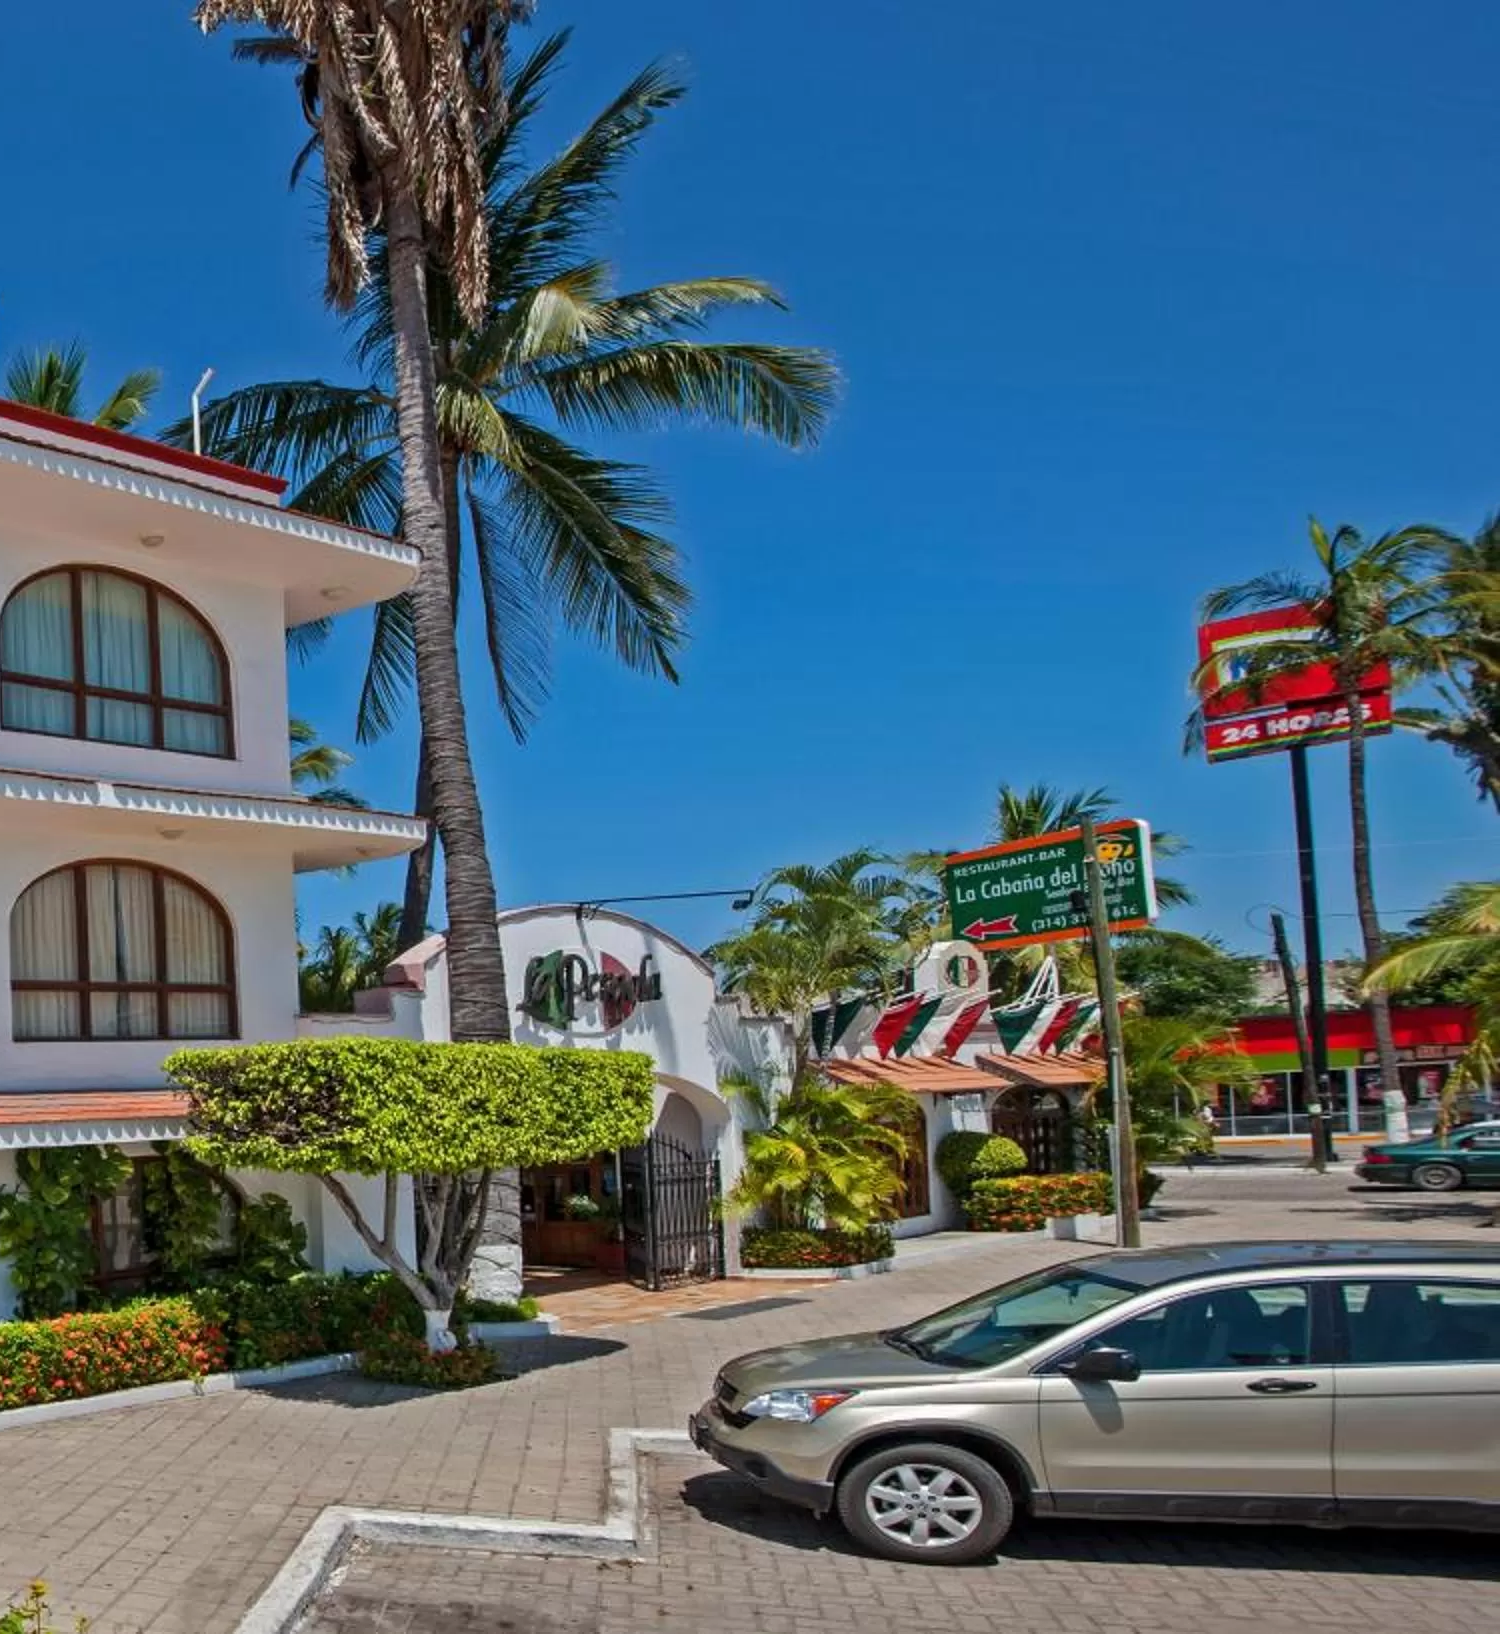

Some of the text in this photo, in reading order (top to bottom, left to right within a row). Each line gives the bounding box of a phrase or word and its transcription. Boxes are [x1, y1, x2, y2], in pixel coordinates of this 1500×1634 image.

[1221, 723, 1260, 744] 24
[956, 884, 977, 904] La
[981, 872, 1045, 899] Cabaña
[1049, 863, 1078, 888] del
